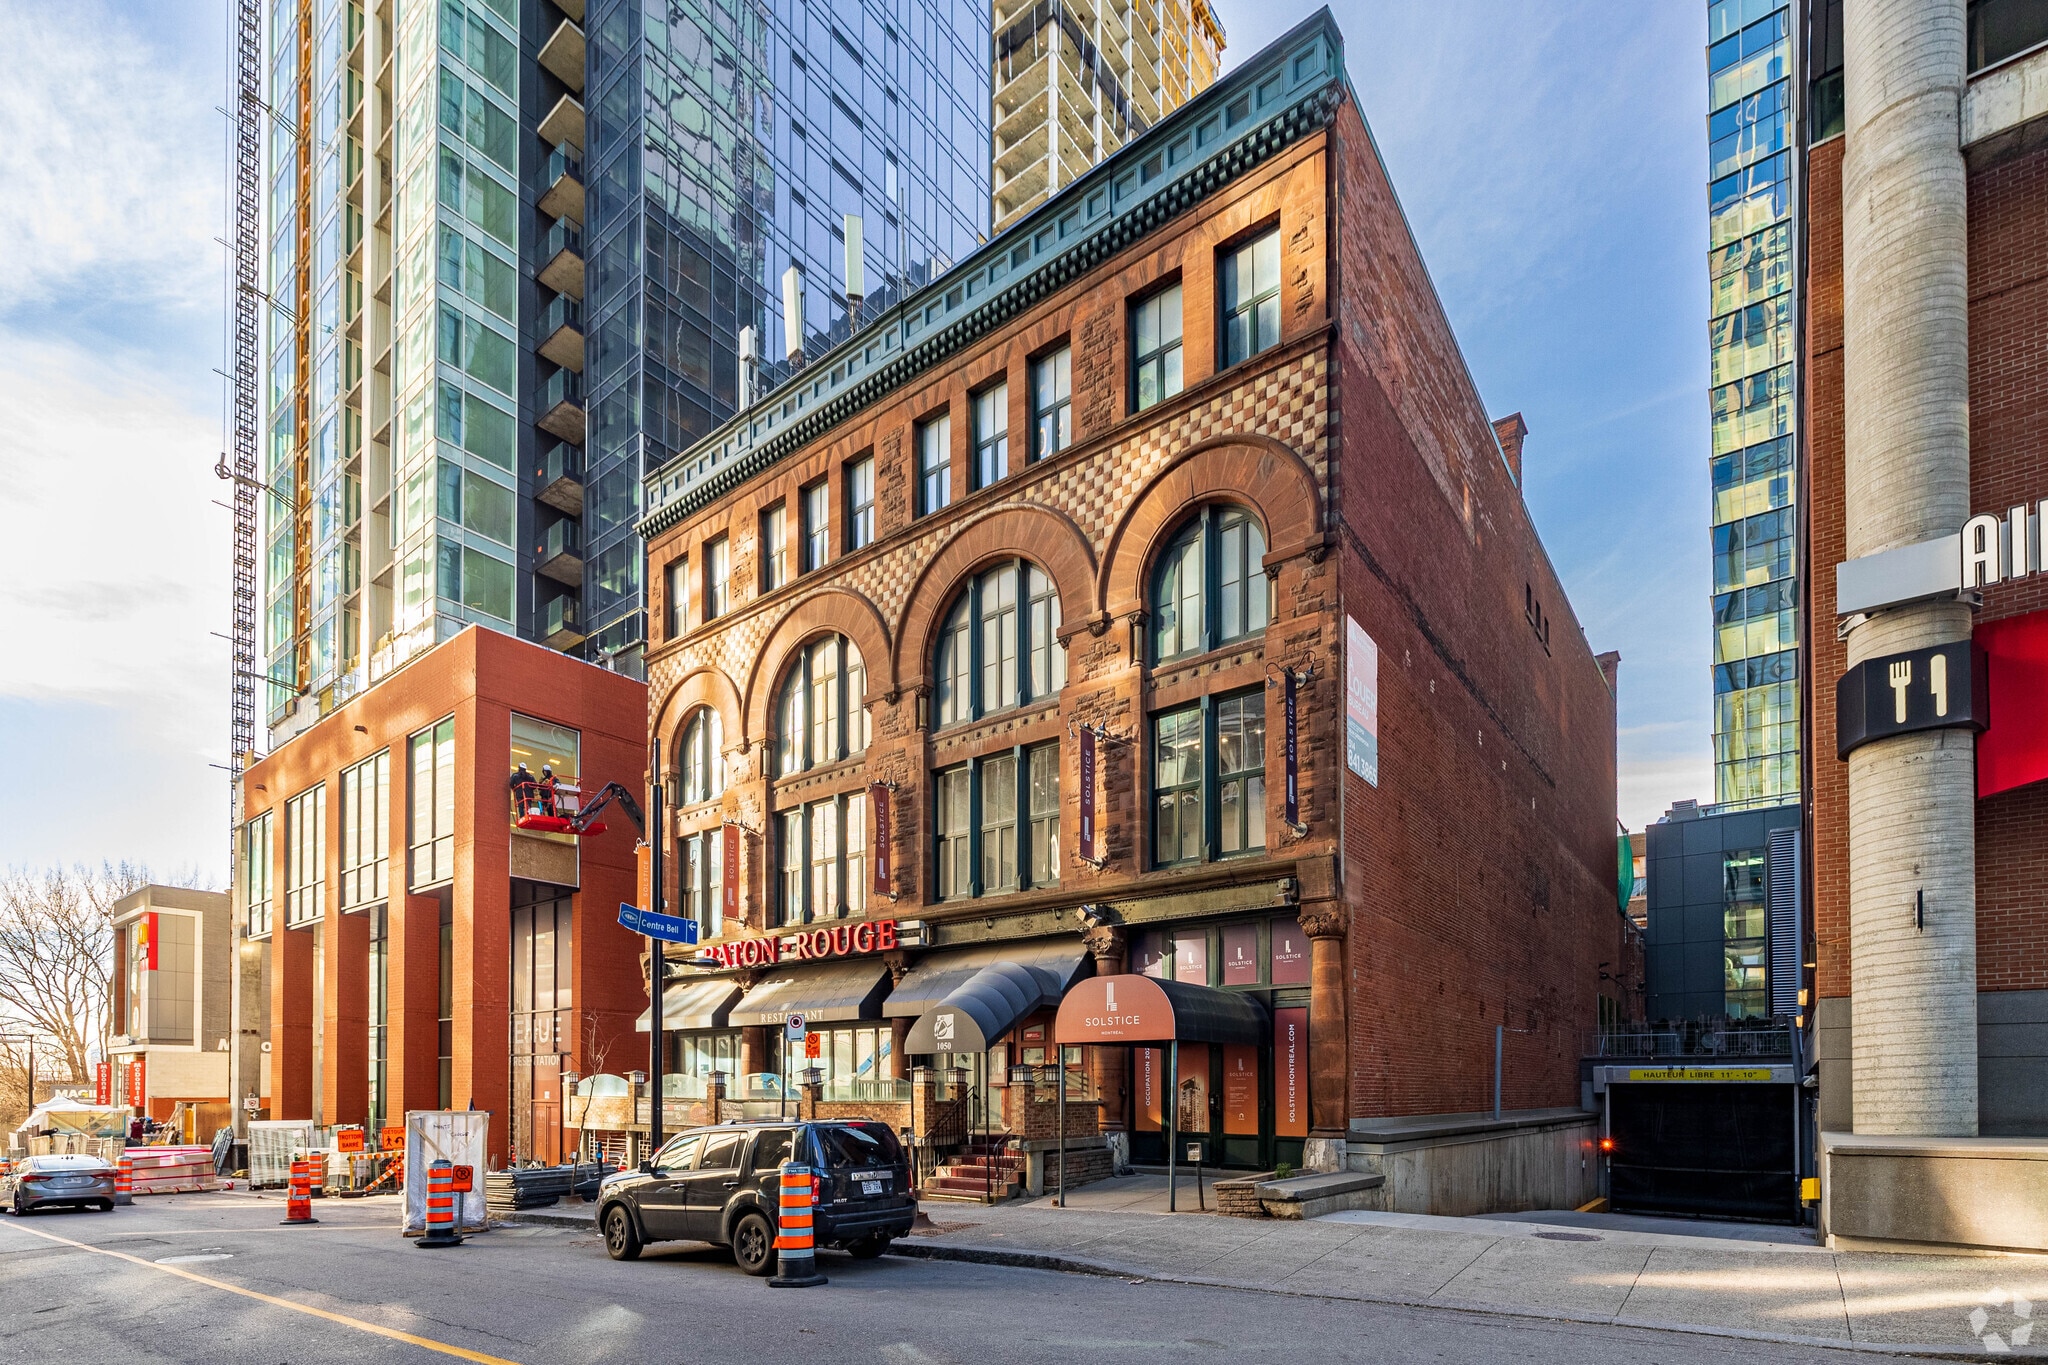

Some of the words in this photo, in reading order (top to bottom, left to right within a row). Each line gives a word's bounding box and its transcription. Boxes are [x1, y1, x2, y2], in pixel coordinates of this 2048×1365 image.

[1348, 674, 1376, 713] LOUER
[642, 920, 665, 932] Centre
[666, 924, 679, 934] Bell
[794, 919, 899, 960] ROUGE
[761, 1009, 824, 1023] RESTAANT
[1085, 1016, 1140, 1026] SOLSTICE
[514, 1017, 562, 1044] ENUE
[936, 1042, 952, 1050] 1050
[513, 1055, 560, 1066] RESETATION
